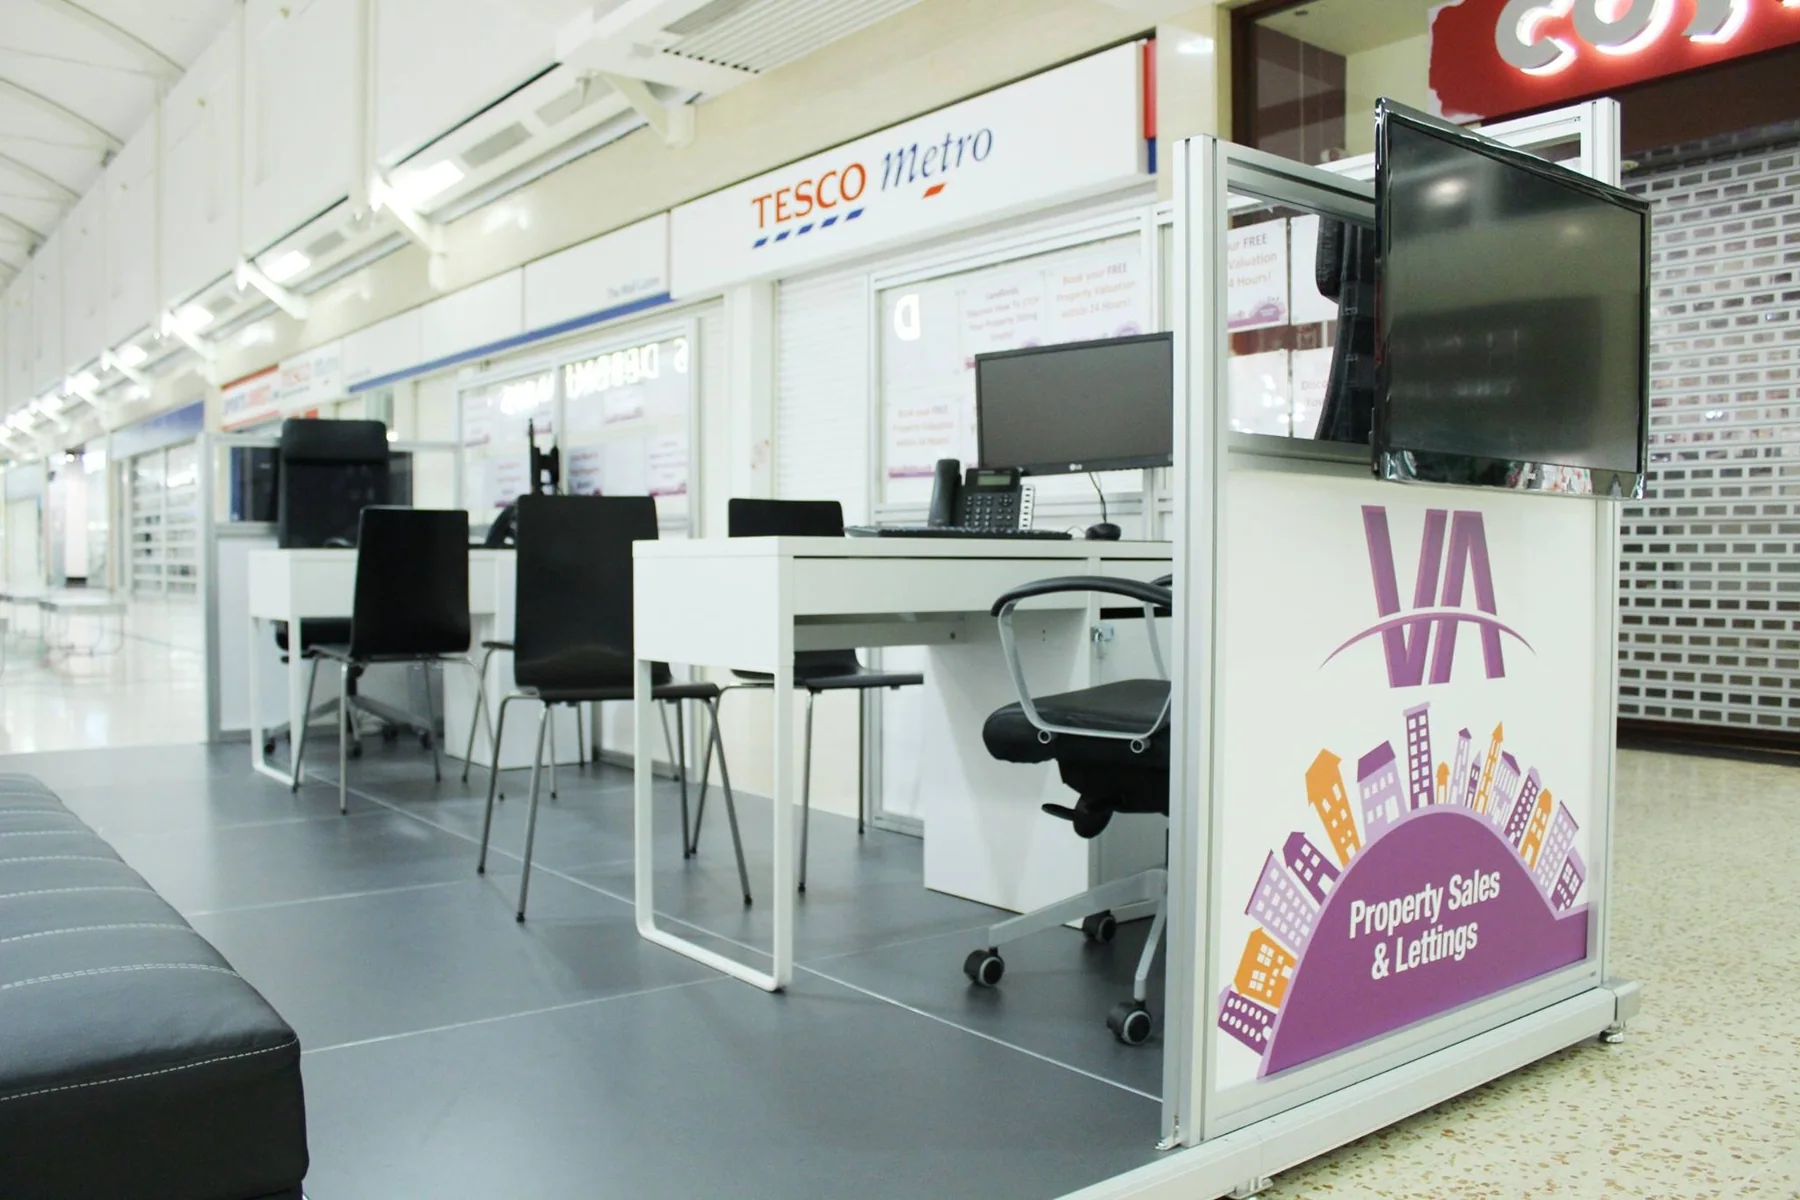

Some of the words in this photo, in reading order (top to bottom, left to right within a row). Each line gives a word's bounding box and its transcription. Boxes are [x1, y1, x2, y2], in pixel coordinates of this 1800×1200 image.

[752, 163, 867, 229] TESCO
[1243, 233, 1269, 249] FREE
[1349, 883, 1443, 941] Property
[1448, 867, 1501, 909] Sales
[1370, 946, 1390, 980] &
[1395, 919, 1478, 974] Lettings
